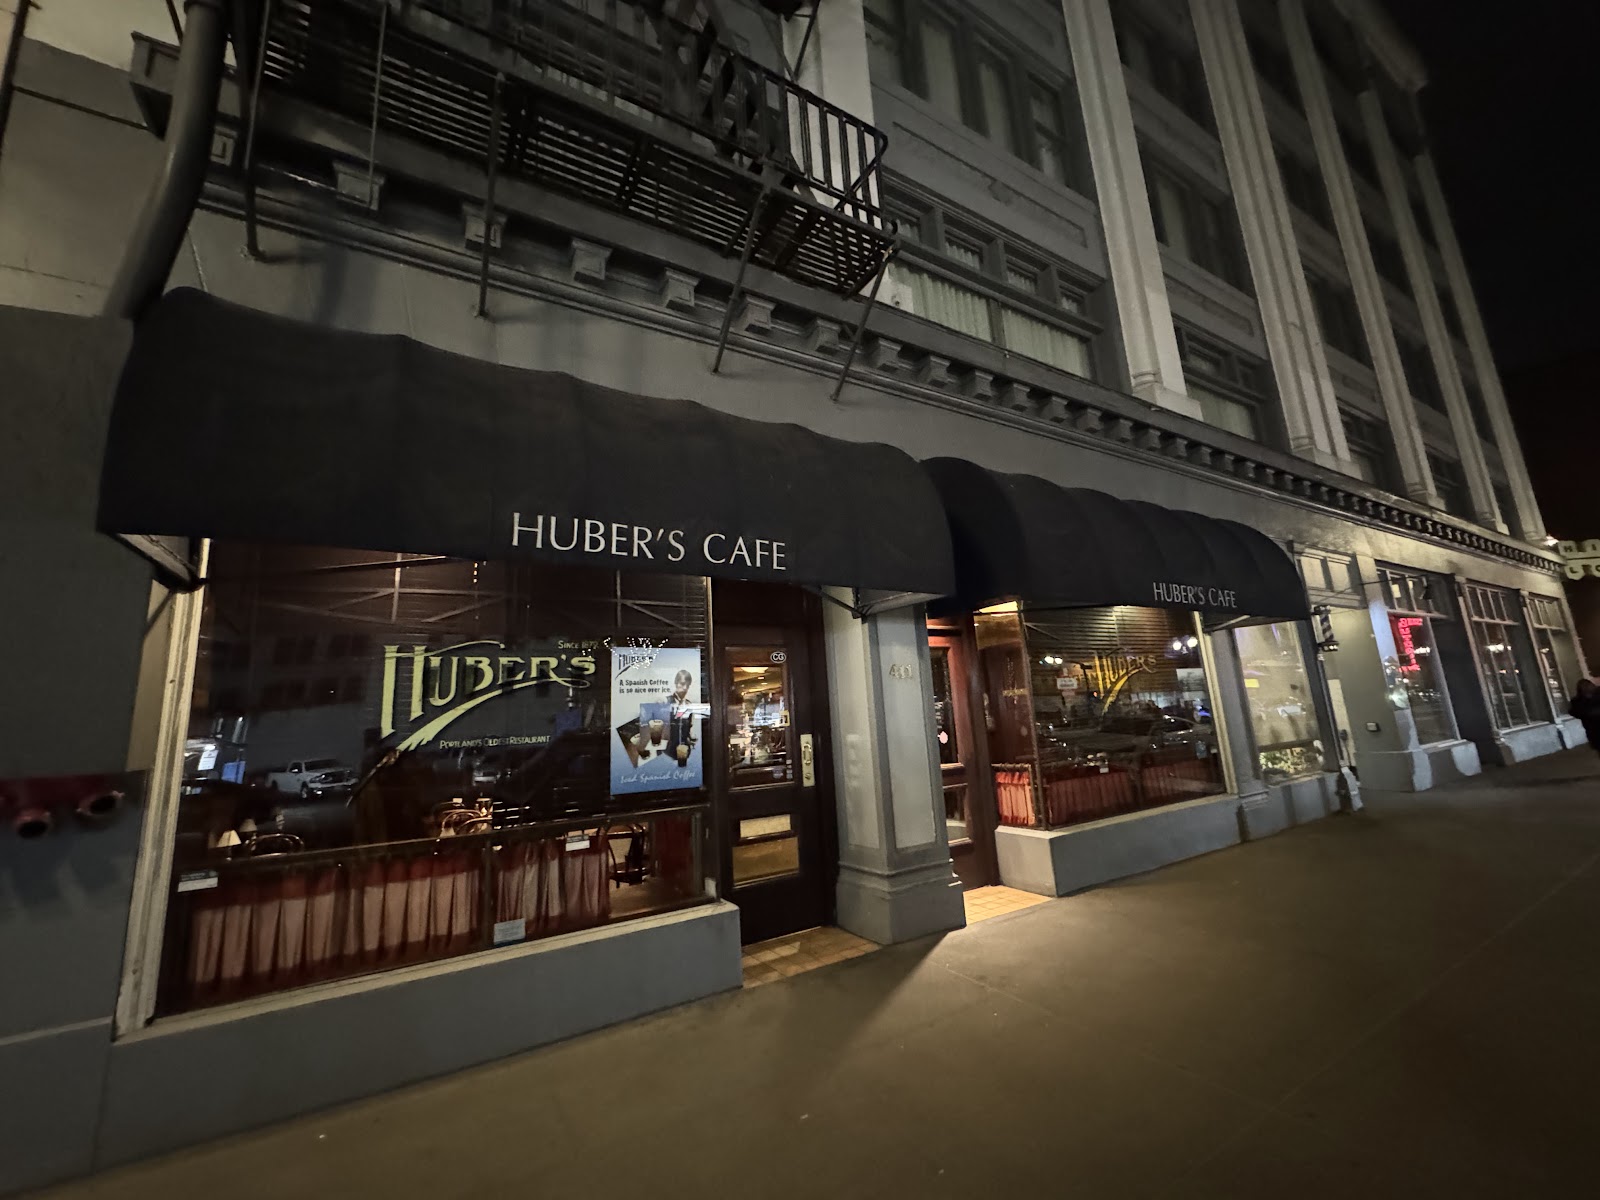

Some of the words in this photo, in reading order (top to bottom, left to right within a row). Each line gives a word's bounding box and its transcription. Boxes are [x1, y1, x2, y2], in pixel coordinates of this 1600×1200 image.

[511, 511, 686, 562] HUBER'S
[703, 533, 787, 570] CAFE
[1153, 582, 1206, 605] HUBER'S
[1208, 588, 1238, 608] CAFE
[558, 639, 579, 649] SINCE
[618, 653, 654, 671] HUBERS
[619, 679, 625, 687] A
[625, 679, 648, 687] Spanish
[649, 679, 669, 687] Coffee
[1091, 650, 1157, 699] HUBERS
[381, 643, 597, 740] HUBER'S
[439, 738, 483, 750] PORTLAND'S
[509, 735, 551, 746] RESTAURANT
[620, 774, 638, 784] Iced
[639, 771, 671, 784] Spanish
[673, 769, 696, 781] Coffee
